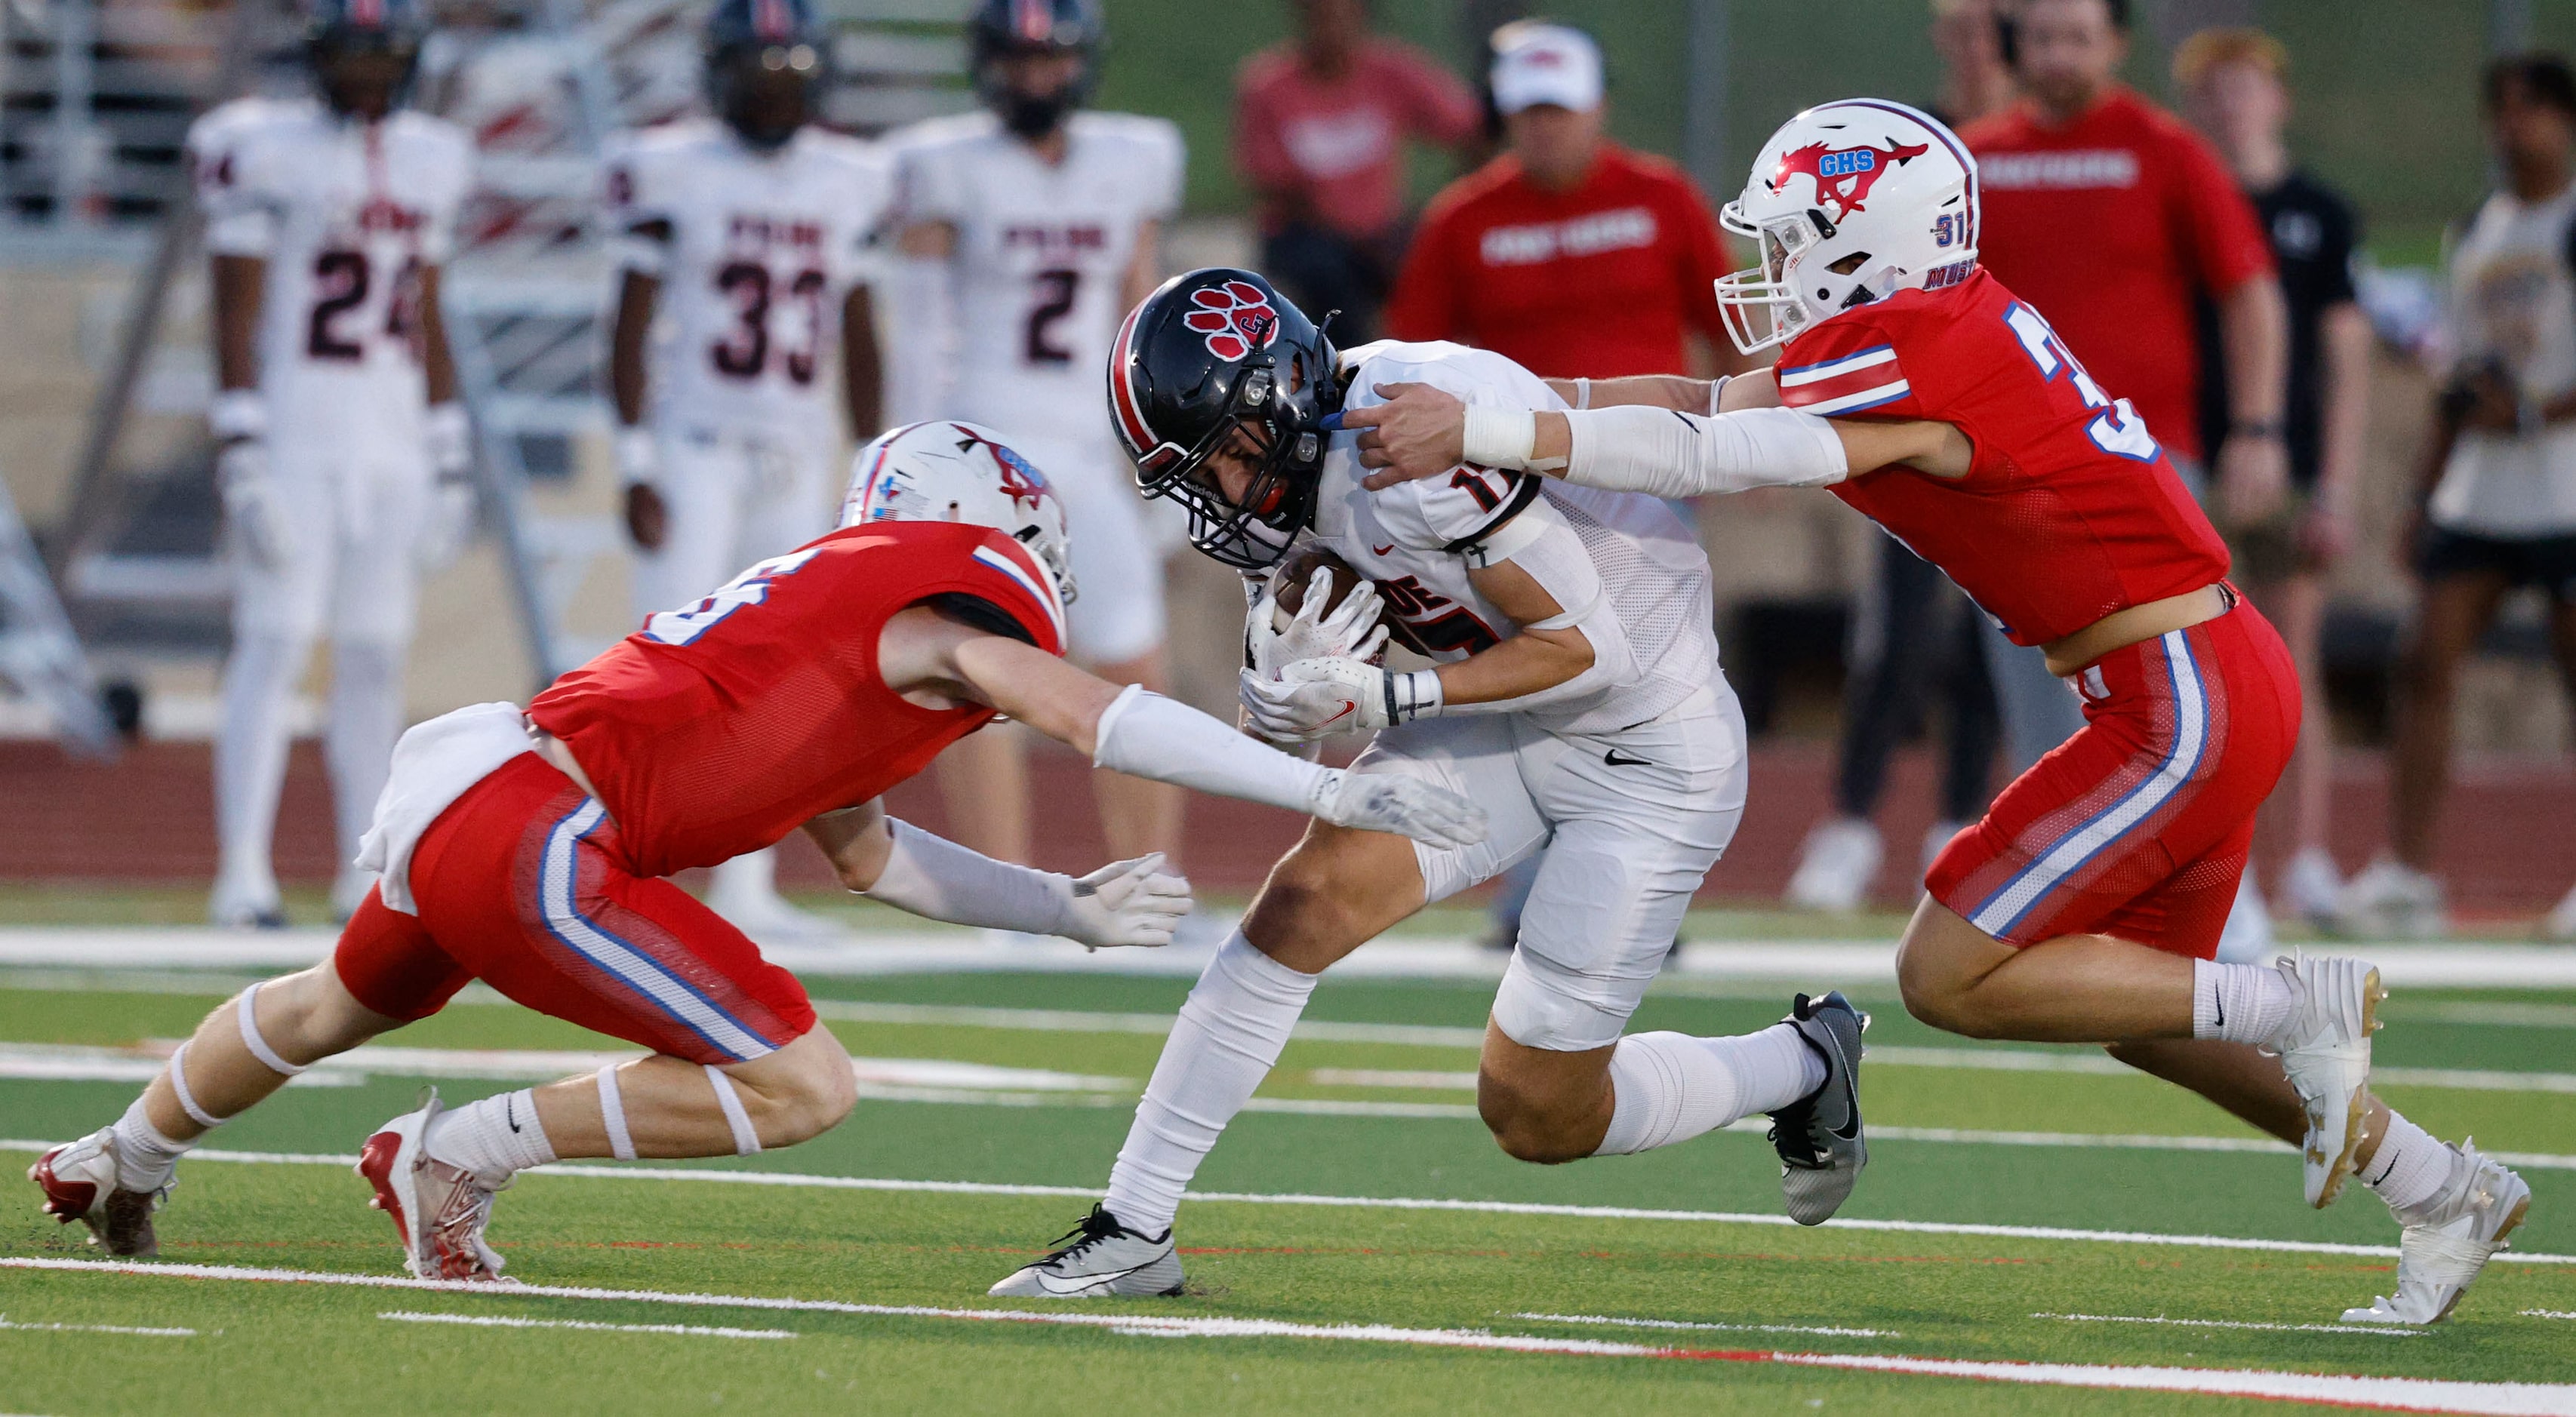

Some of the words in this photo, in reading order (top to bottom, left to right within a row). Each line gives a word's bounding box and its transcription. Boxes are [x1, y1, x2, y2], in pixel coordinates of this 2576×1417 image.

[1818, 149, 1875, 177] GHS
[1937, 211, 1965, 248] 31
[713, 260, 825, 385] 33
[1028, 266, 1078, 362] 2
